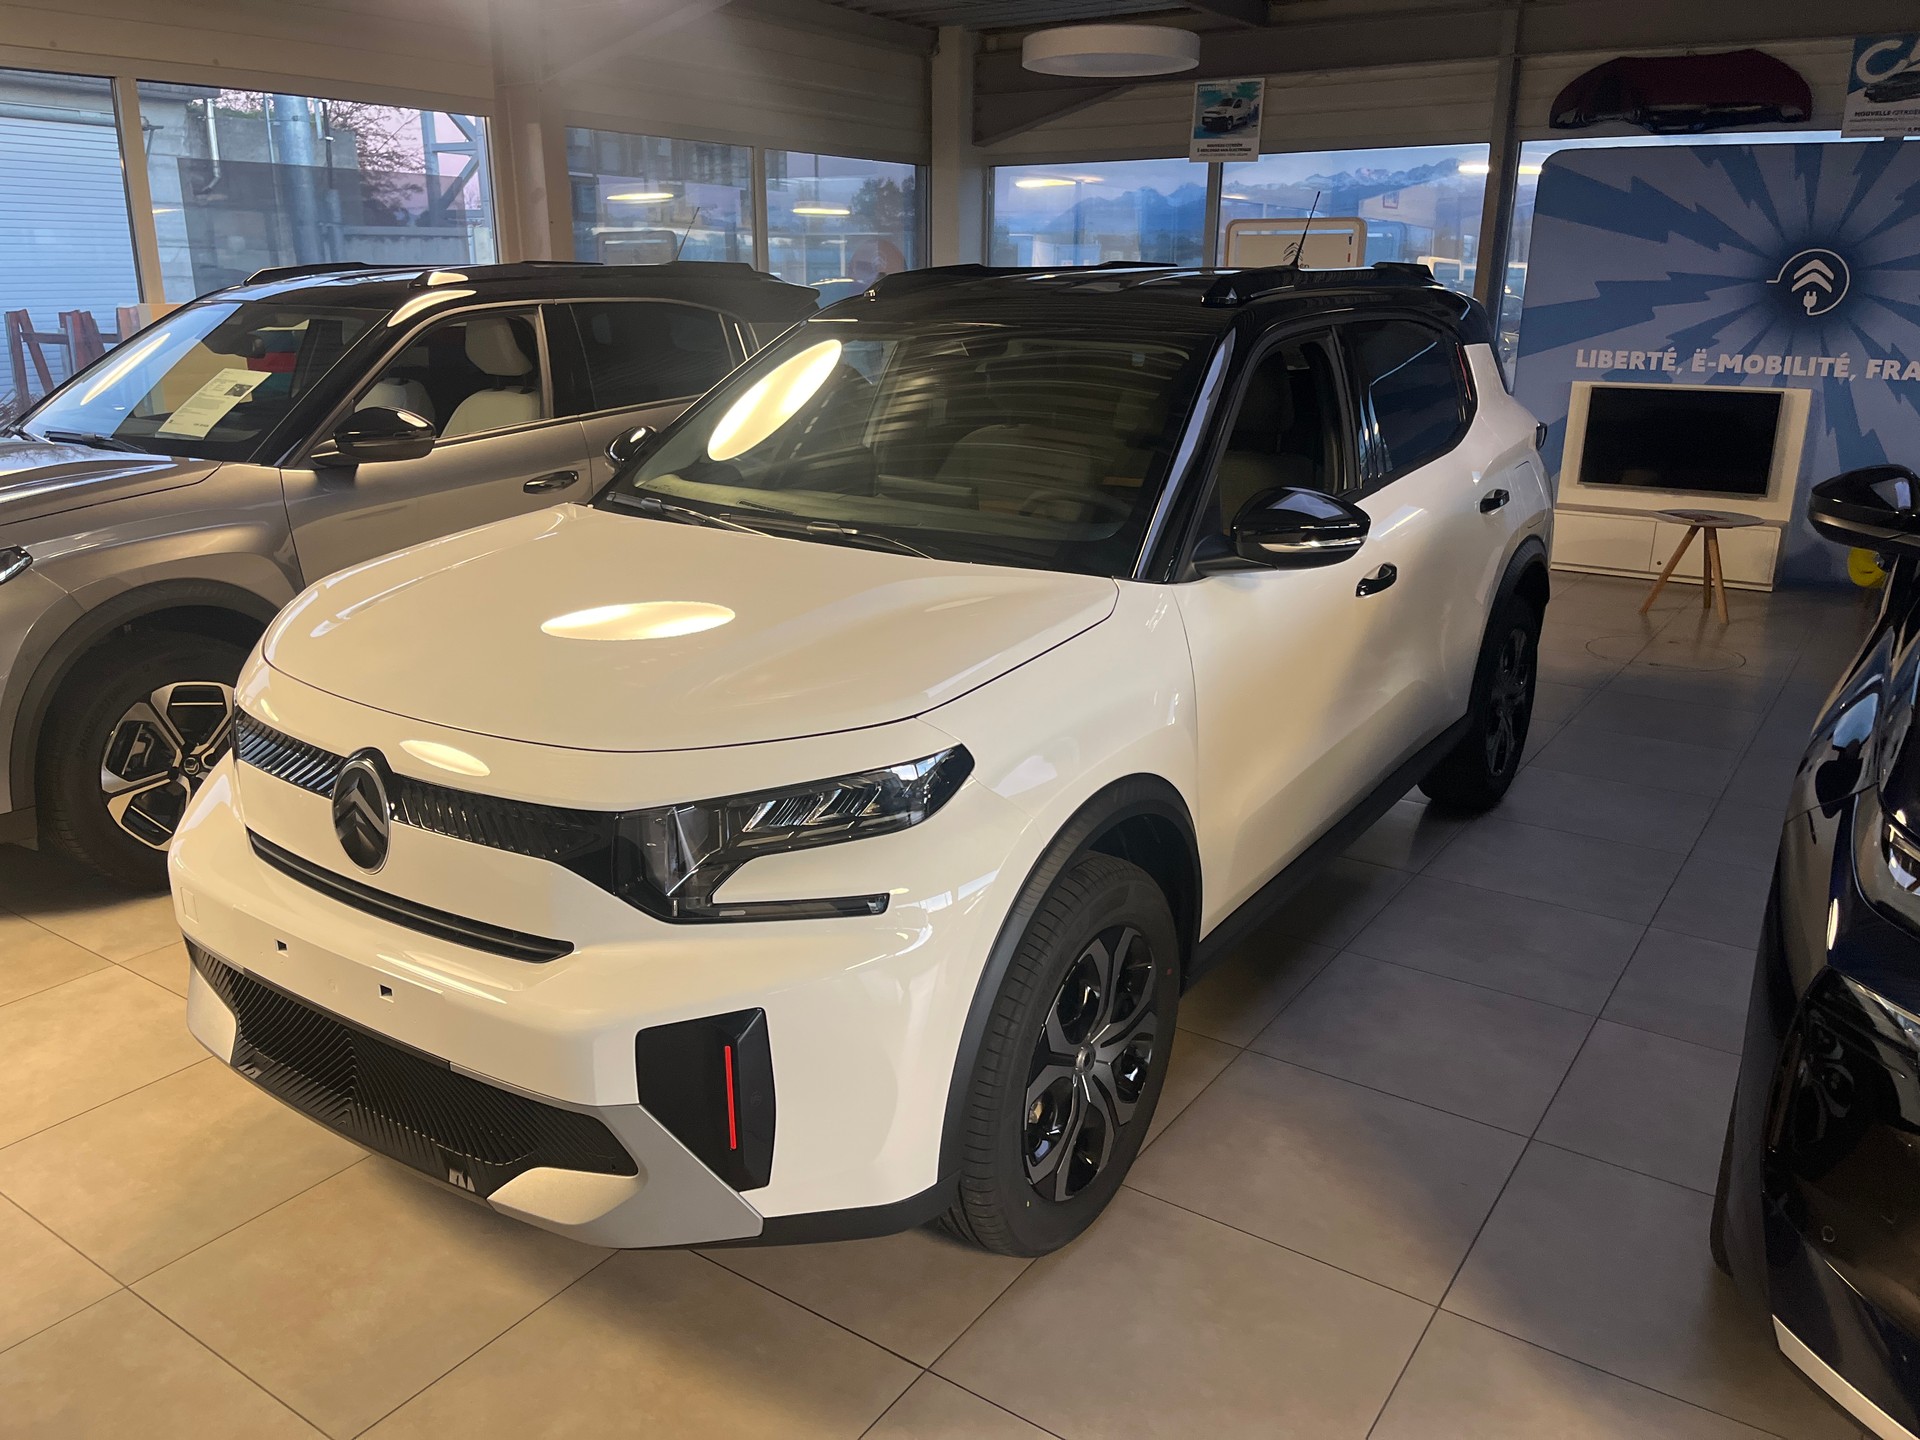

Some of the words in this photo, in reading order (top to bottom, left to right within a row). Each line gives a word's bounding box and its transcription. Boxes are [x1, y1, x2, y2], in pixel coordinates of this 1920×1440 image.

[1575, 346, 1683, 375] LIBERTÉ,
[1691, 348, 1857, 382] Ë-MOBILITÉ,
[1865, 358, 1920, 382] FRA
